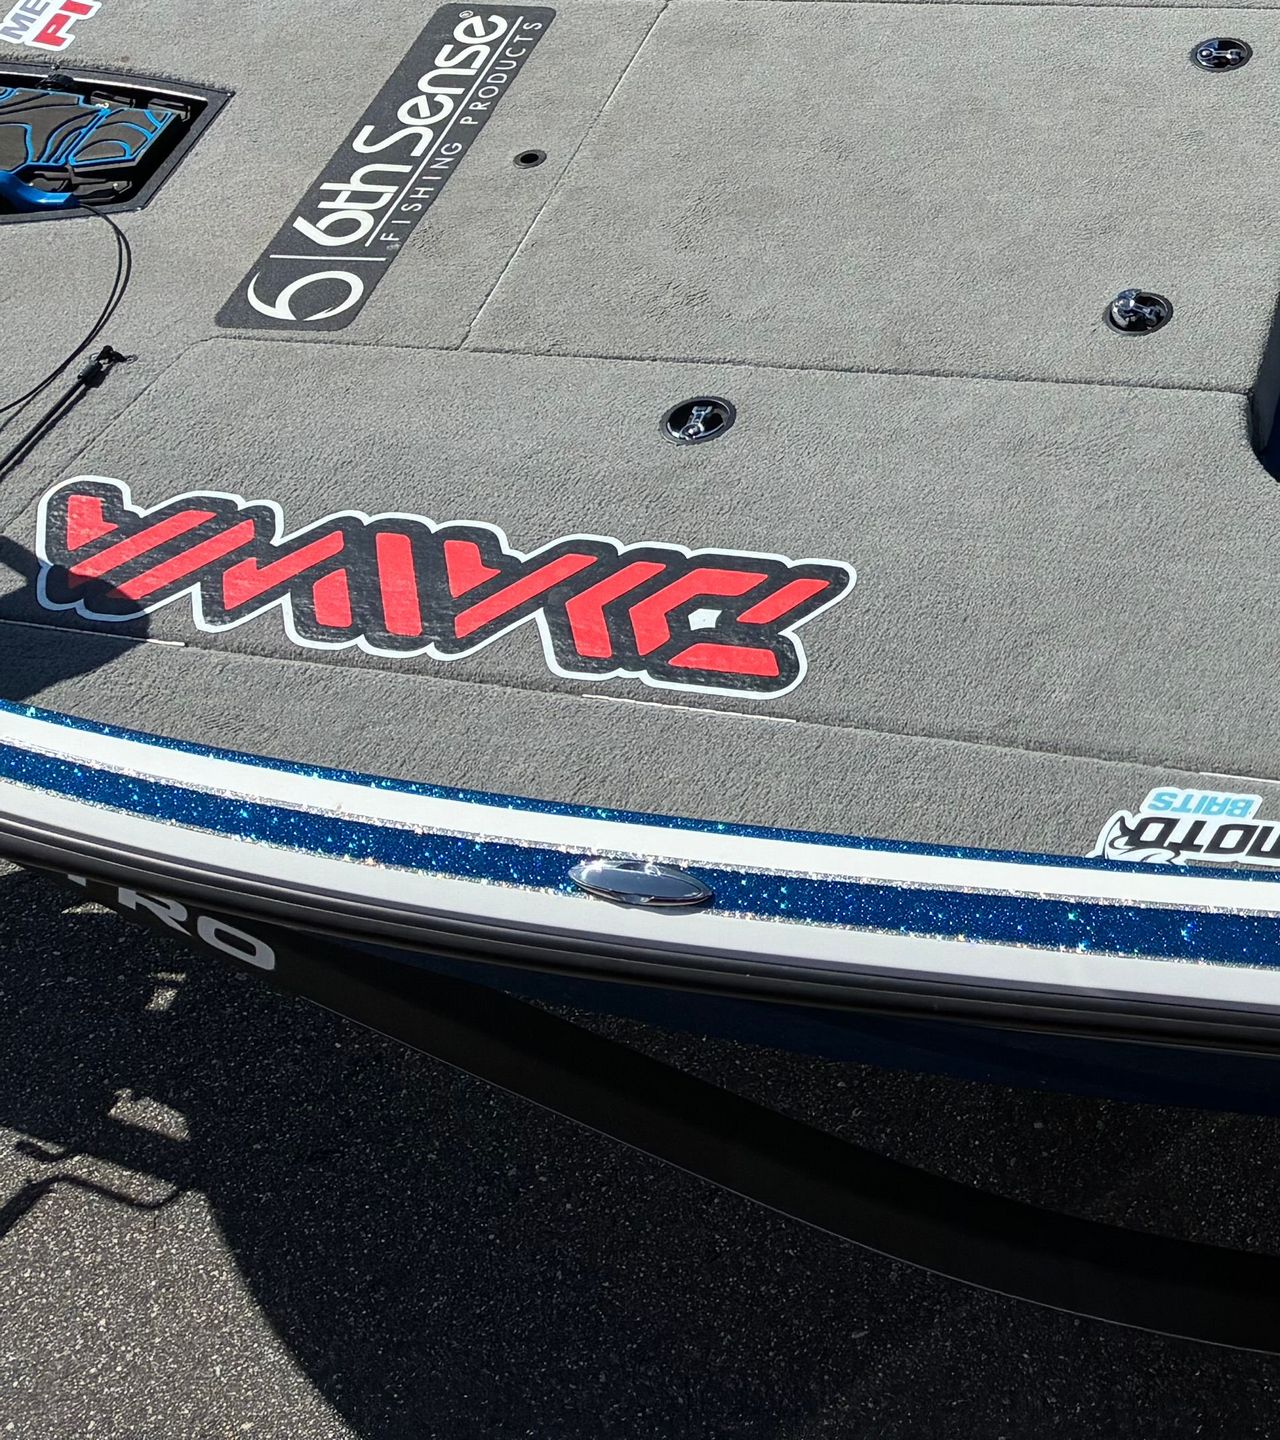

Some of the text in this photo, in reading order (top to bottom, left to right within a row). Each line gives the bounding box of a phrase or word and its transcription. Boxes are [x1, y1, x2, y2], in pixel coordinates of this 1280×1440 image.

[352, 14, 508, 157] Sense
[380, 21, 544, 242] FISHING PRODUCTS
[292, 163, 413, 246] 6th
[1148, 790, 1255, 818] BAITS
